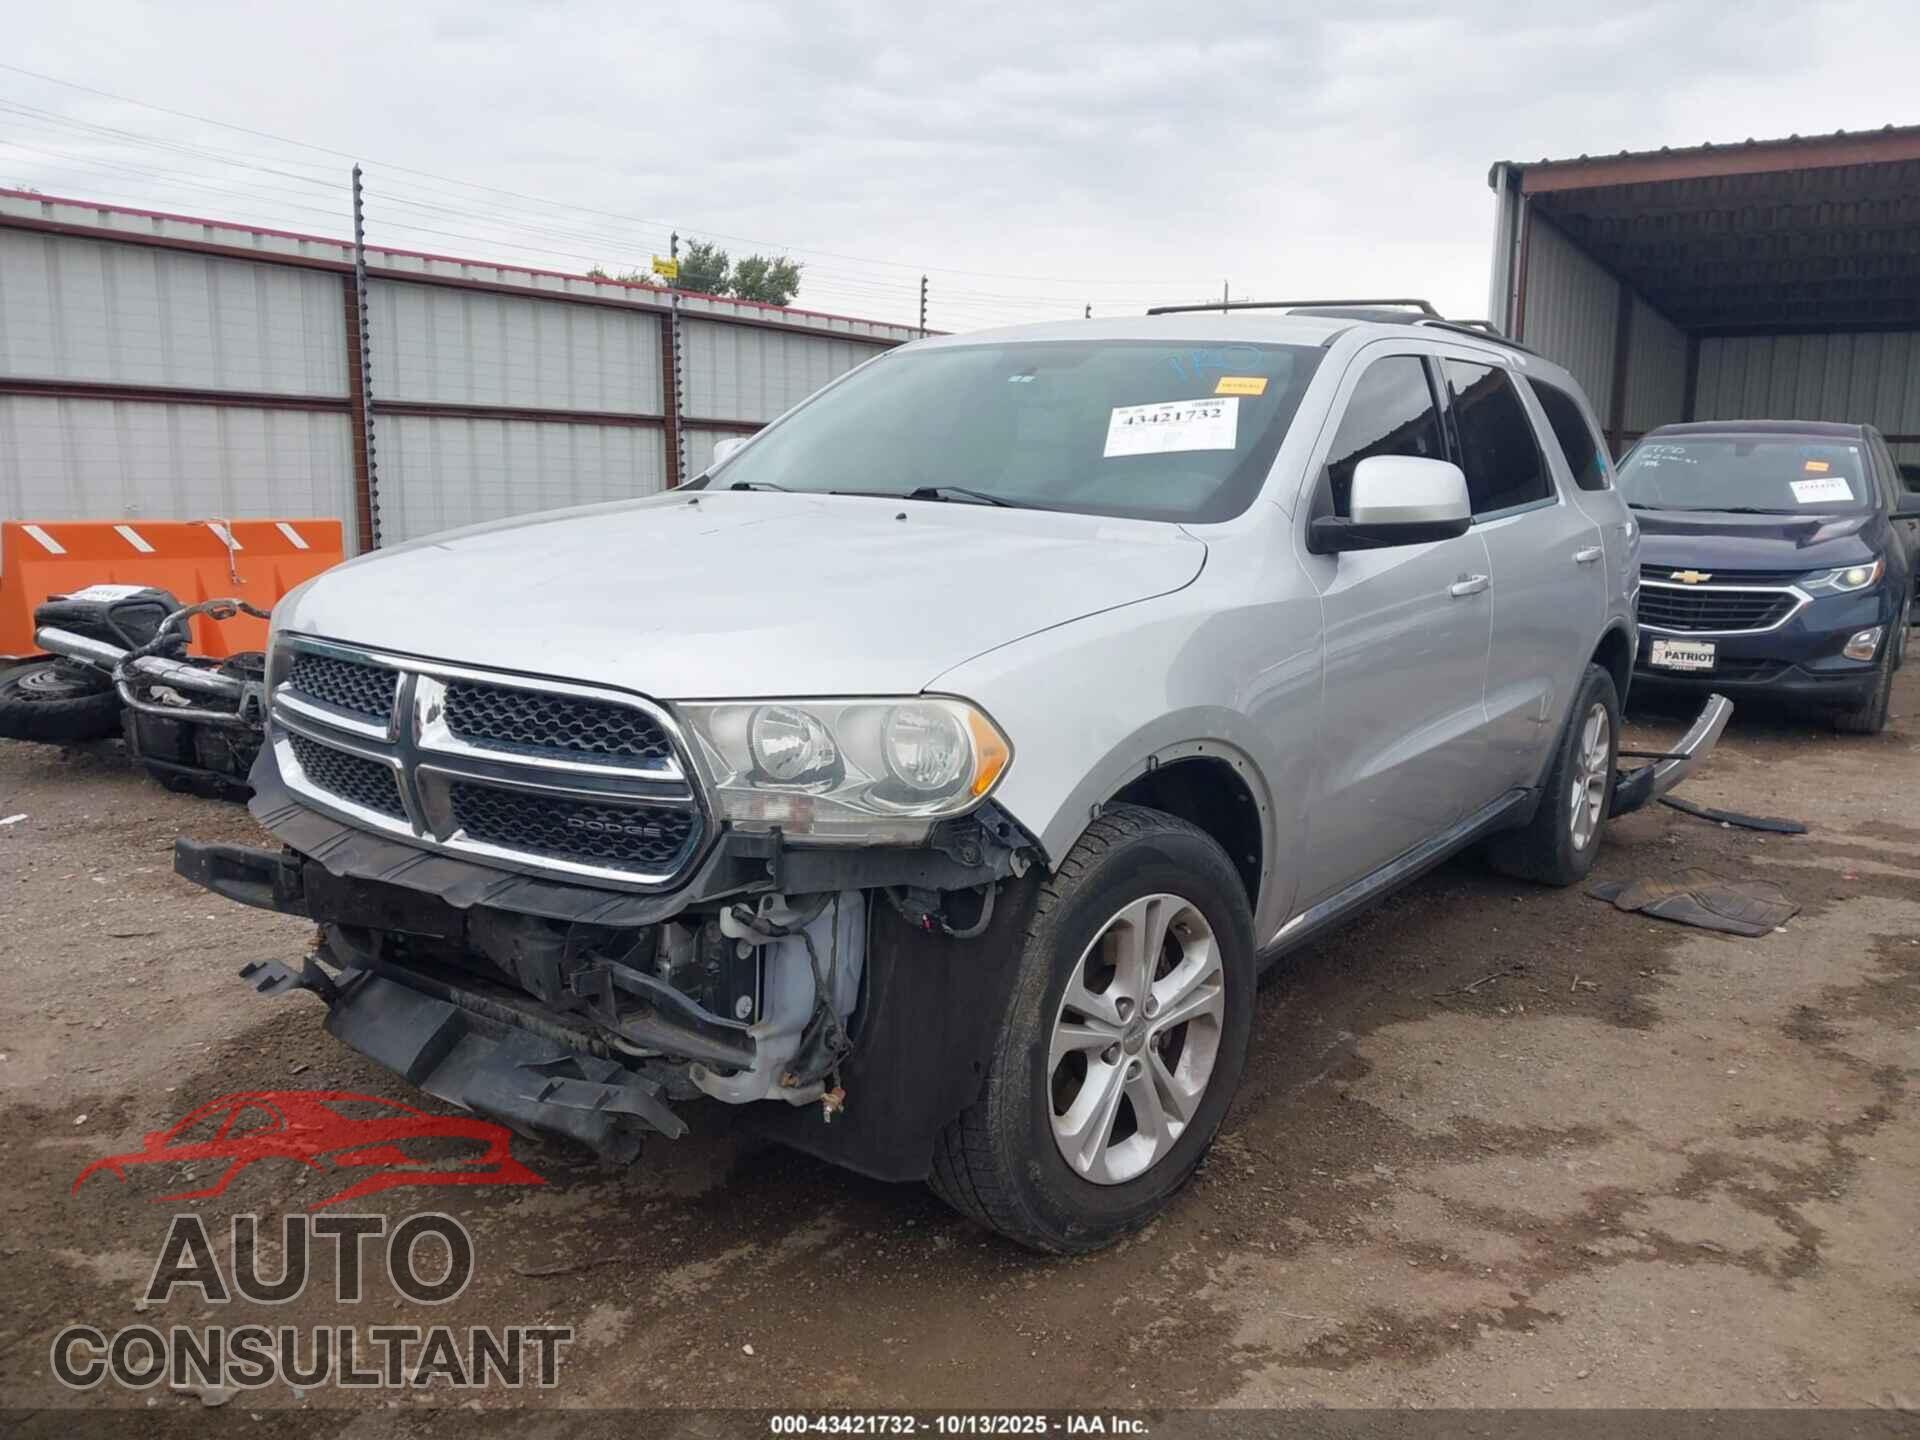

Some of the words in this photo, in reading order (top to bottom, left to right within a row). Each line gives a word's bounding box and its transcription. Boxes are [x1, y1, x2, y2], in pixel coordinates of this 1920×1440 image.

[1122, 408, 1222, 425] 43421732
[1664, 650, 1715, 662] PATRIOT
[567, 818, 662, 838] DODGE
